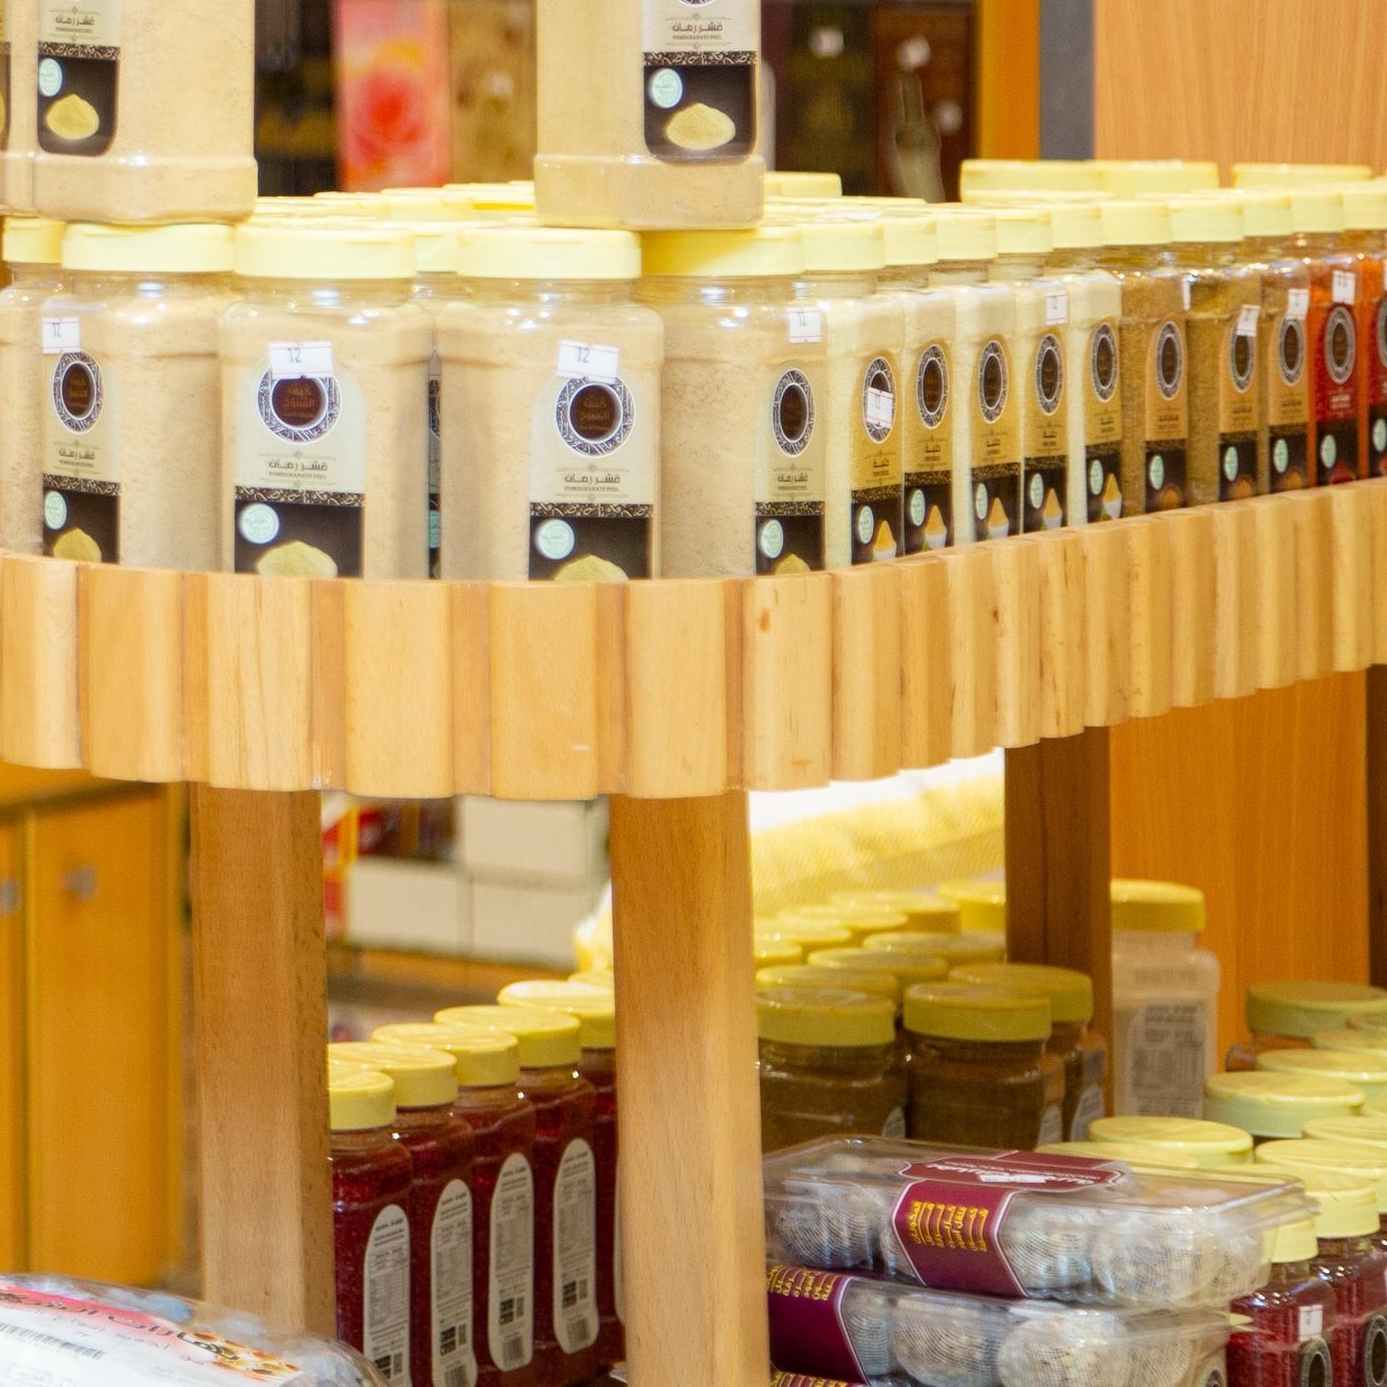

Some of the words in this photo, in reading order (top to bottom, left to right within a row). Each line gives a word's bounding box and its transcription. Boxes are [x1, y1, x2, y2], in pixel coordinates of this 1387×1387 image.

[672, 21, 697, 34] رمان
[698, 20, 724, 34] قشر
[268, 459, 299, 472] رمان
[300, 460, 329, 472] قشر
[564, 472, 593, 485] رمان
[595, 472, 621, 485] قشر
